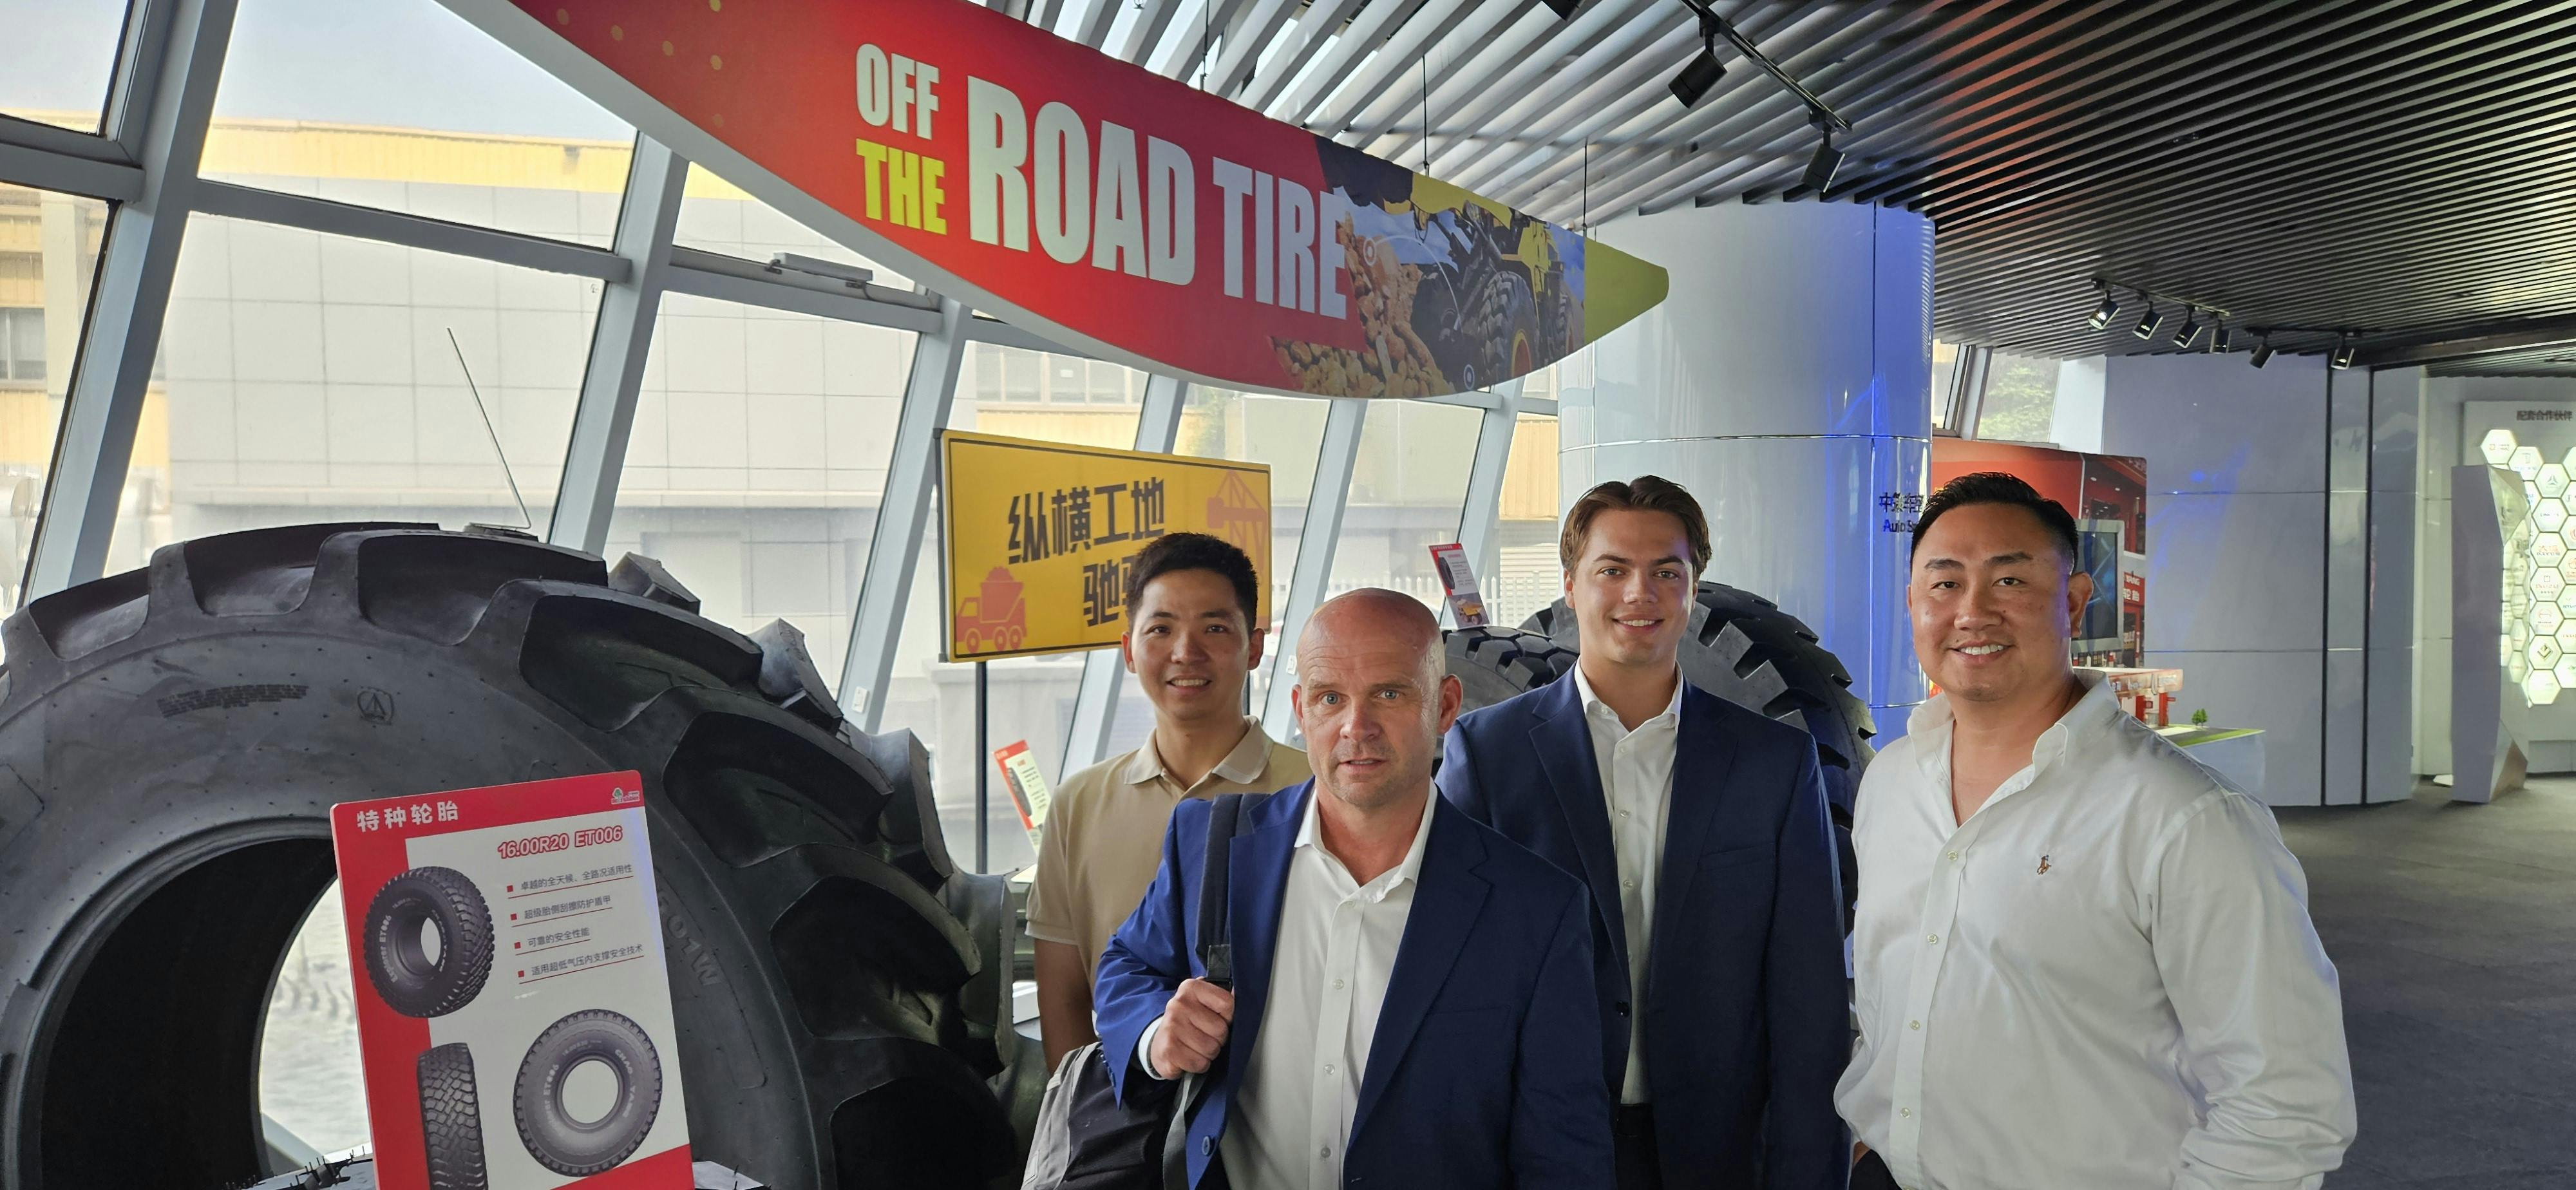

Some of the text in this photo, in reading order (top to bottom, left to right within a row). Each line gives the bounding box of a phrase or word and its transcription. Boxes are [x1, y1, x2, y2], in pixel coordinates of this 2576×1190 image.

[855, 43, 940, 140] OFF
[855, 138, 947, 236] THE
[967, 75, 1347, 321] ROAD TIRE
[1007, 477, 1166, 565] 纵横工地
[356, 800, 459, 833] 特种轮胎
[497, 826, 623, 860] 16.00R20 ET006
[520, 864, 632, 891] 卓越的全天候、全路况适用性
[527, 927, 591, 948] 可靠的安全性能
